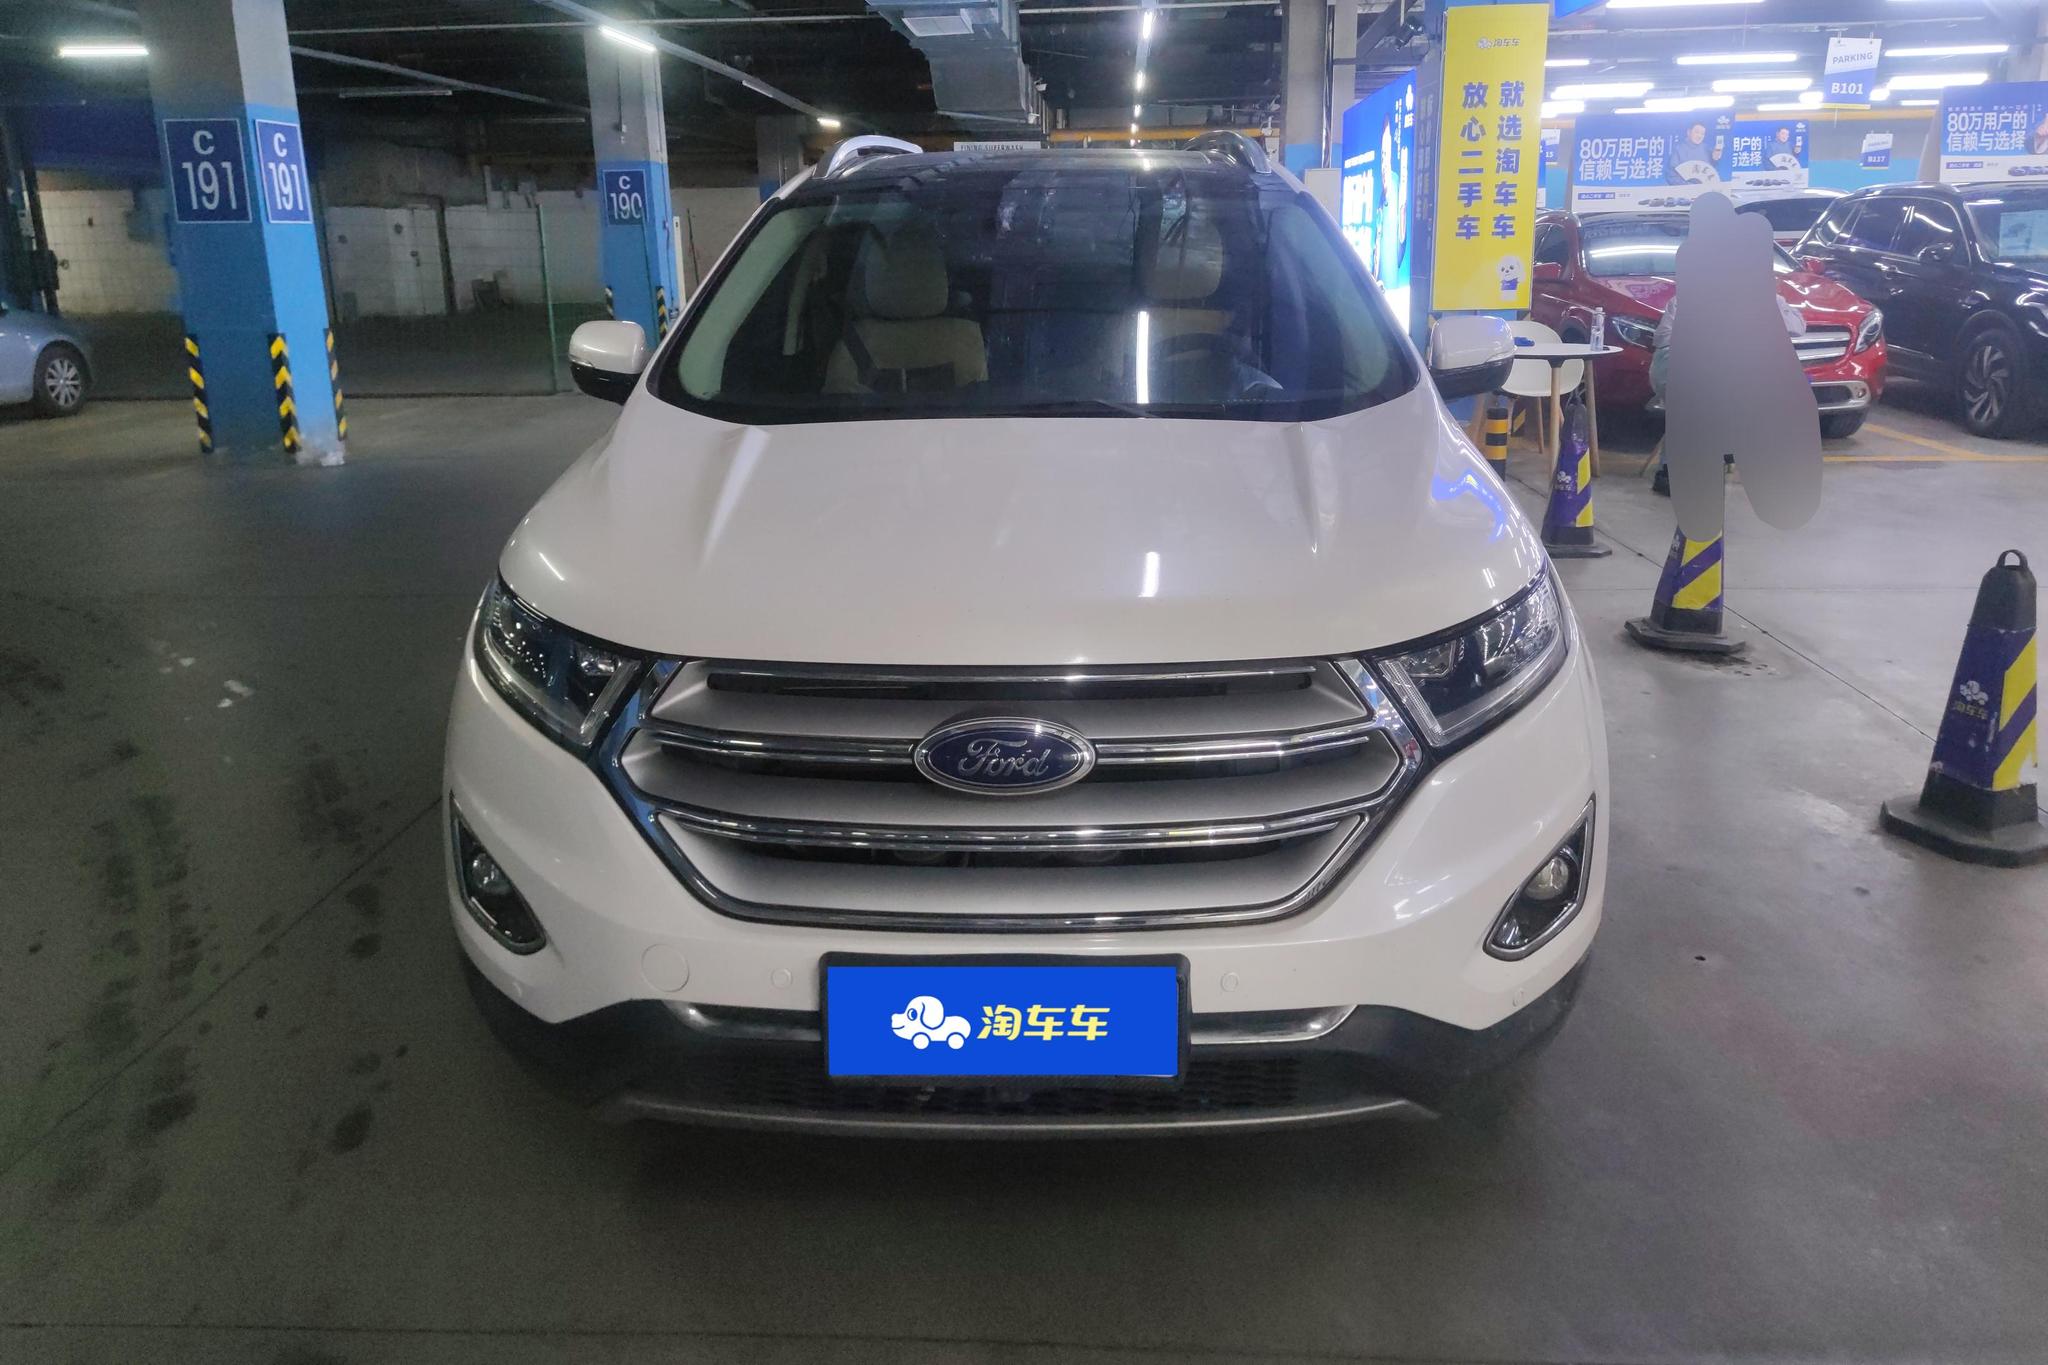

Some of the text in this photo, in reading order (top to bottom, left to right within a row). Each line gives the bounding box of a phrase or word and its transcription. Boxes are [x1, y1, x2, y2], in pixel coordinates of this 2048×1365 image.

[1832, 51, 1874, 64] PARKING
[1831, 82, 1863, 95] B101
[1946, 111, 2027, 132] 80万用户的
[193, 130, 215, 155] C
[273, 132, 287, 157] C
[1579, 135, 1665, 160] 80万用户的
[1946, 130, 2026, 152] 信赖与选择
[1455, 81, 1489, 240] 放心二手车
[1491, 81, 1525, 239] 就选淘车车
[1578, 157, 1664, 181] 信赖与选择
[182, 161, 237, 210] 191
[268, 162, 304, 211] 191
[619, 175, 631, 190] C
[610, 192, 643, 219] 190
[958, 738, 1051, 776] Ford
